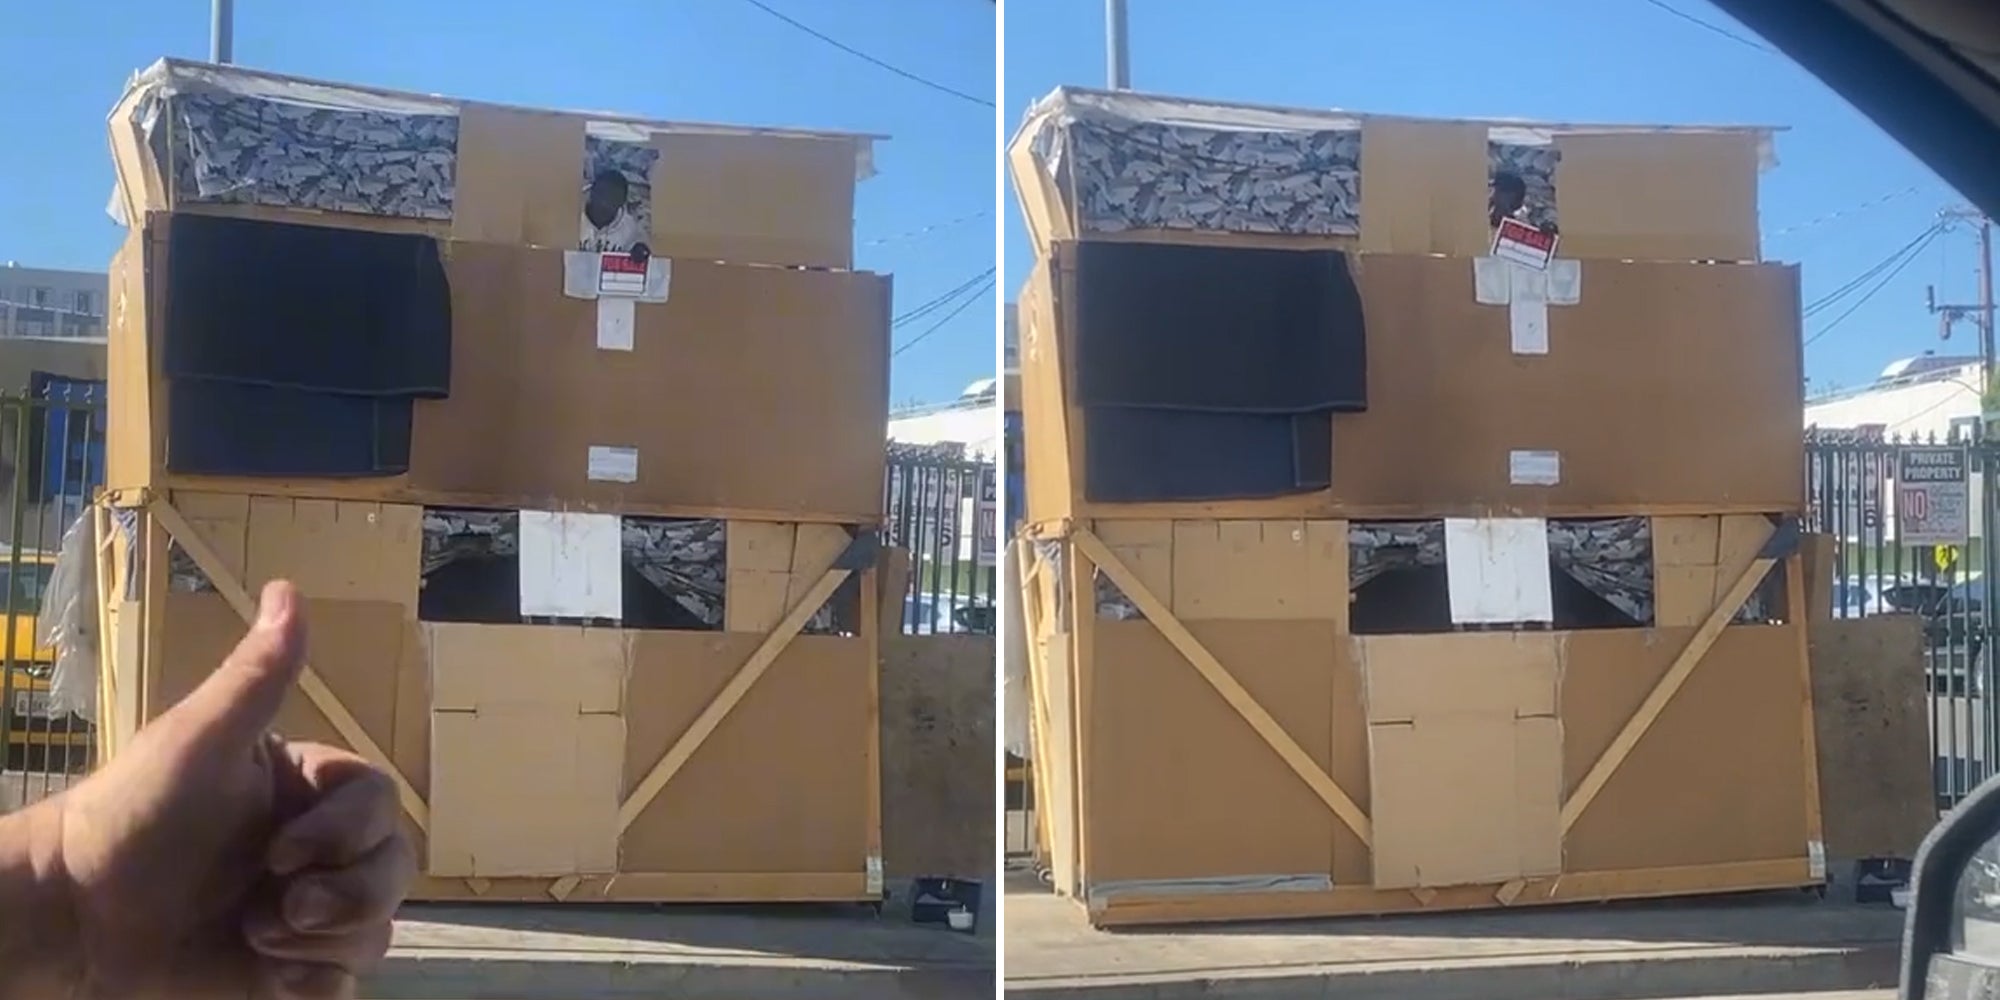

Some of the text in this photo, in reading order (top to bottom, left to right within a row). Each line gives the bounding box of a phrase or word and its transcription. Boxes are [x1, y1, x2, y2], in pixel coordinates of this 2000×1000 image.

[1502, 222, 1551, 249] FOR SALE
[603, 256, 620, 270] FOR
[1910, 452, 1956, 465] PRIVATE
[1905, 467, 1962, 479] PROPERTY
[1904, 490, 1925, 519] NO
